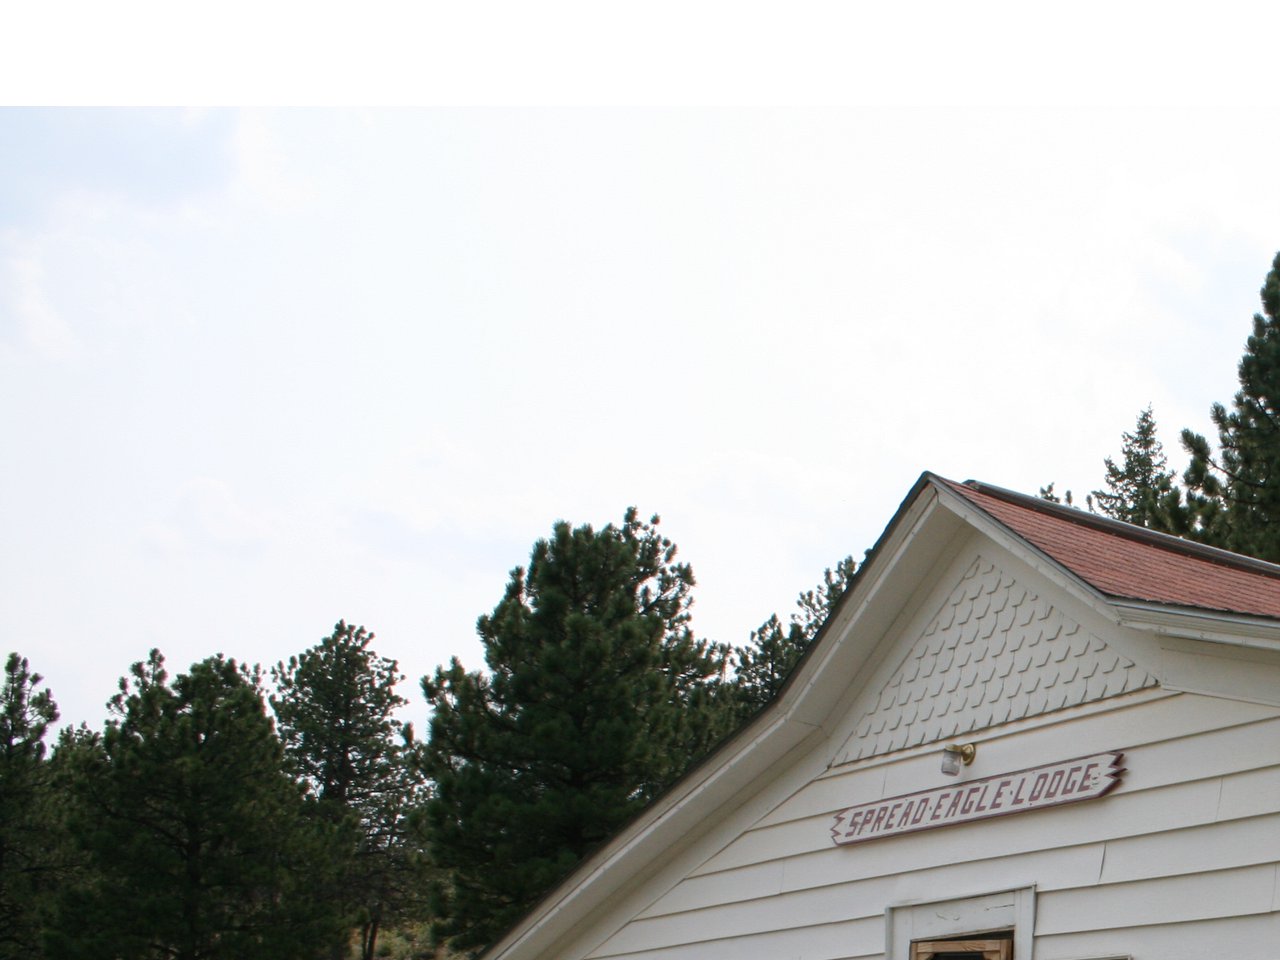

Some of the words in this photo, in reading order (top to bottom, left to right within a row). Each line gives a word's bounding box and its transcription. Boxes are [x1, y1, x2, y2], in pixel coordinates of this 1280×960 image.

[845, 797, 930, 838] SPREAD
[930, 780, 1011, 821] EAGLE
[1011, 763, 1099, 806] LODGE
